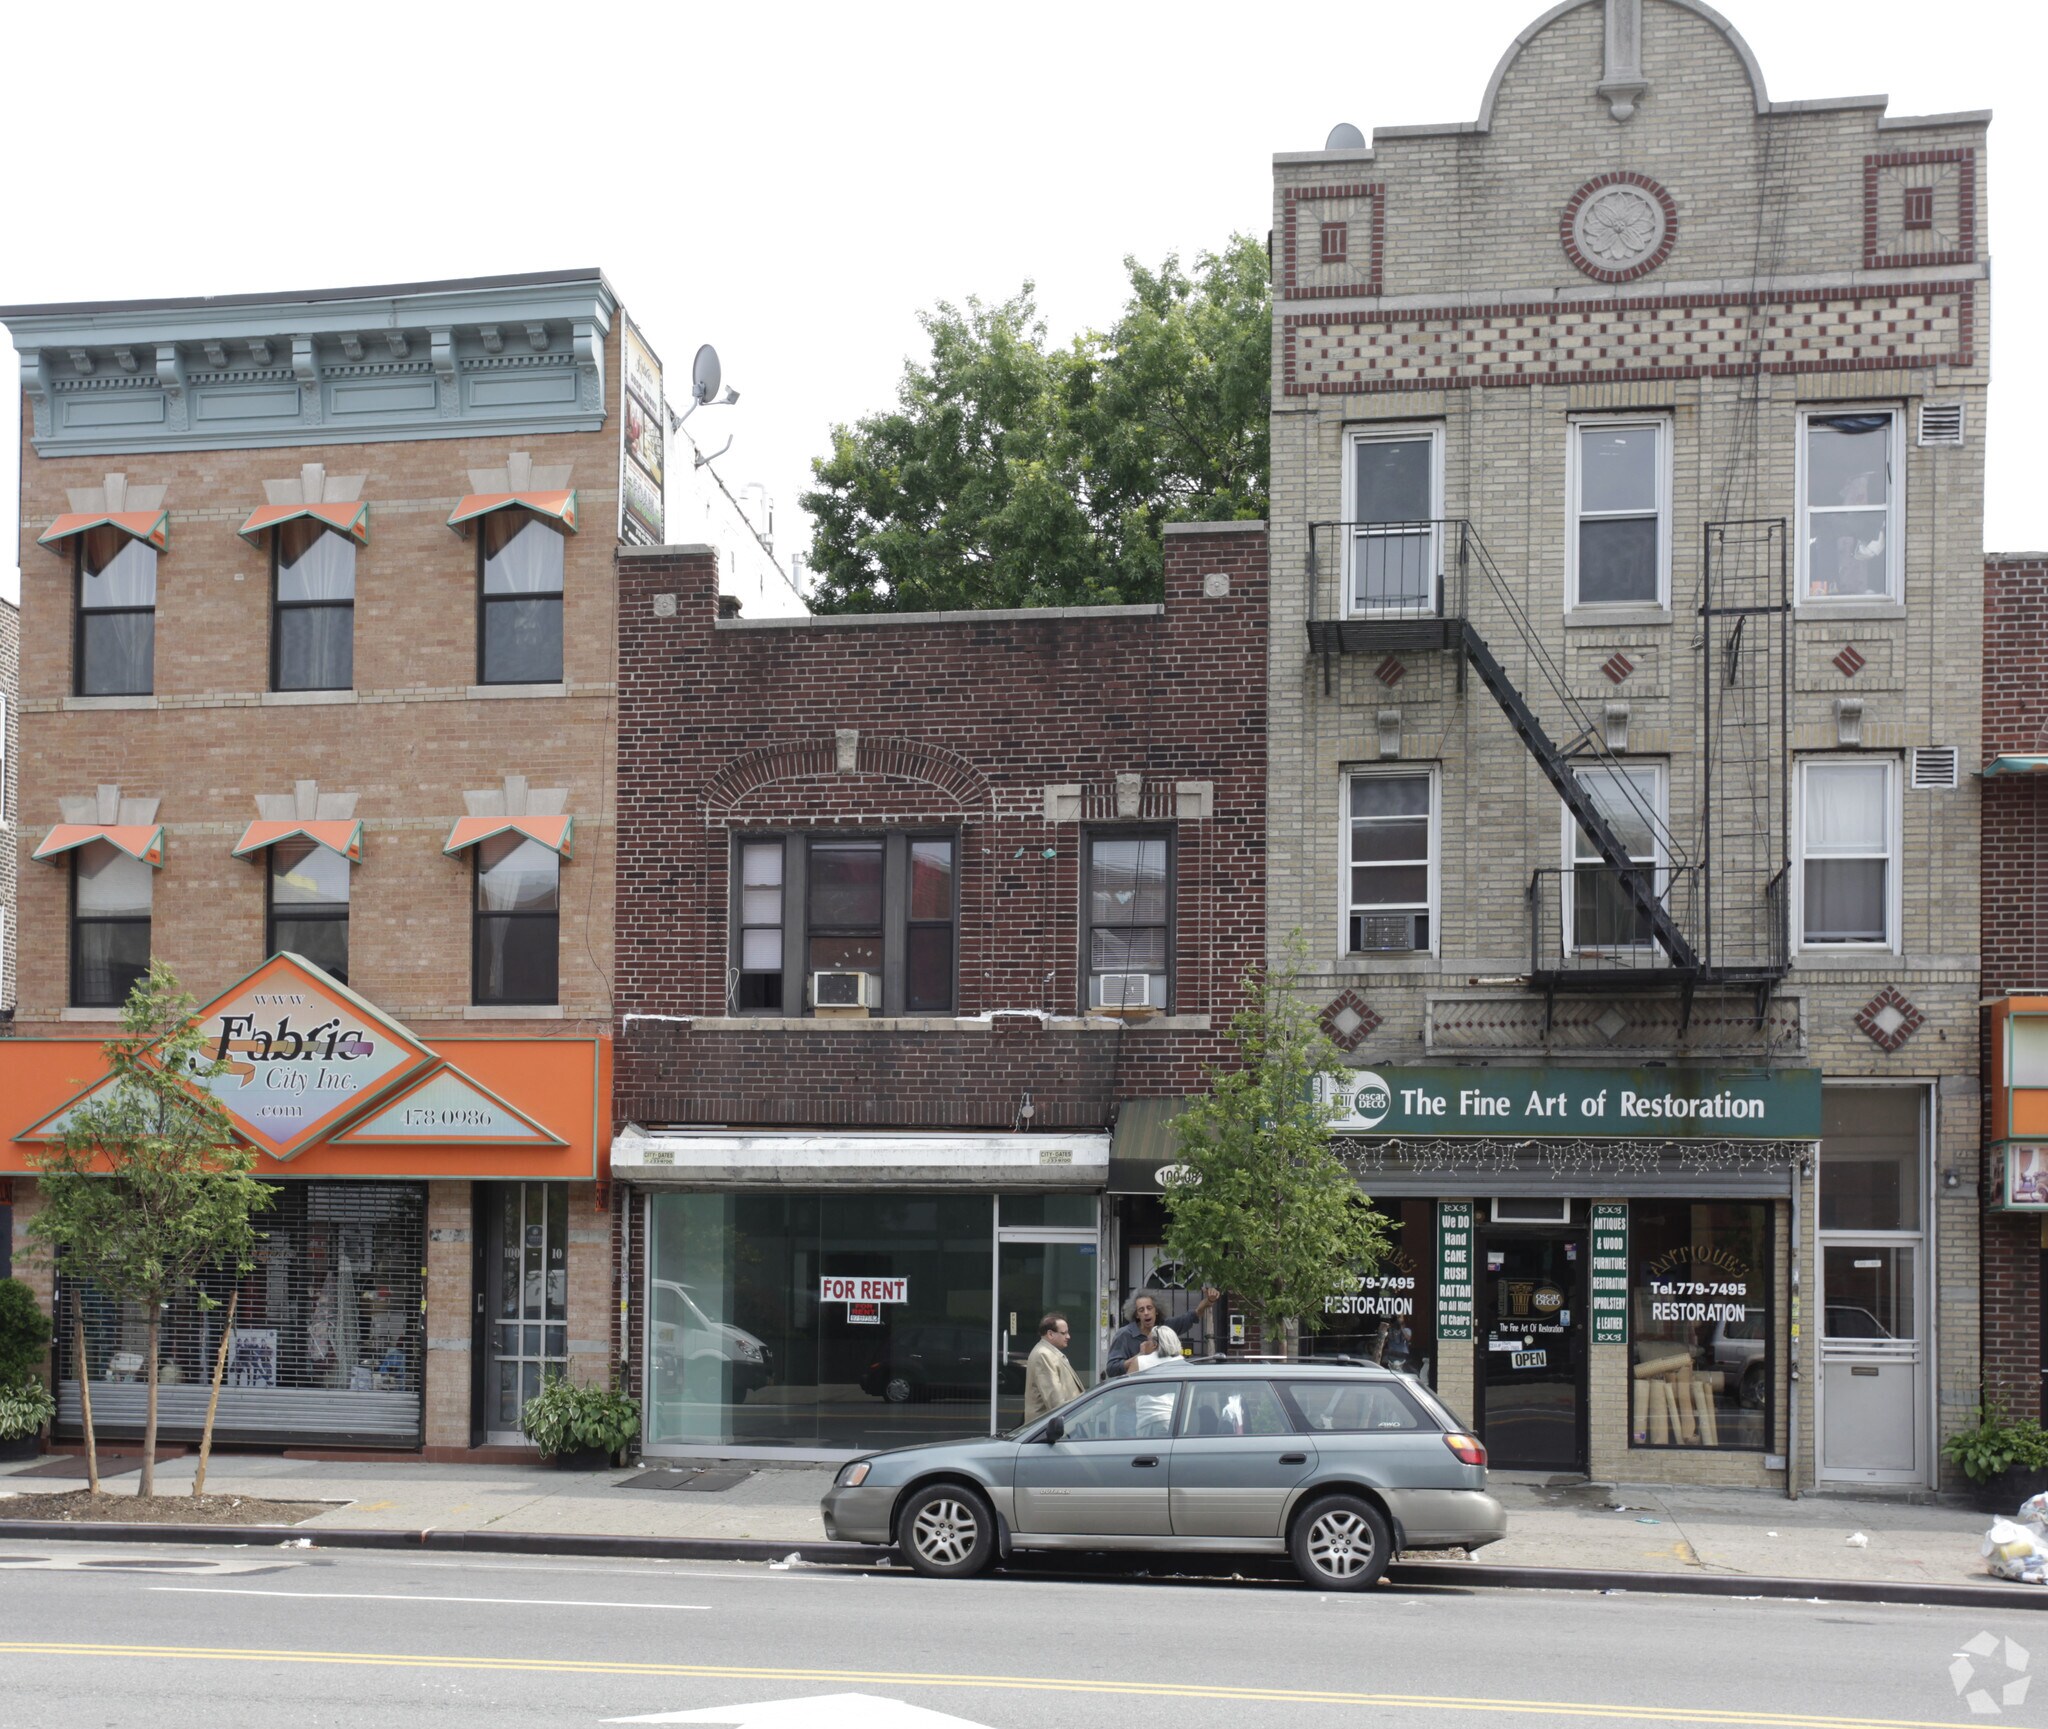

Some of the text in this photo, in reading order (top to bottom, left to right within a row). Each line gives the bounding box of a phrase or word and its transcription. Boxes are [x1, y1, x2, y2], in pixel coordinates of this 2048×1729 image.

[254, 994, 313, 1009] www.
[189, 1013, 373, 1077] Fabric
[266, 1067, 358, 1095] City Inc.
[1358, 1093, 1385, 1101] oscar
[1400, 1088, 1764, 1118] The Fine Art of Restoration
[1359, 1100, 1386, 1108] DECO
[256, 1104, 303, 1118] .com
[1442, 1215, 1469, 1228] We DO
[1594, 1217, 1626, 1230] ANTIQUES
[1445, 1232, 1466, 1245] Hand
[1597, 1237, 1623, 1250] & WOOD
[1445, 1250, 1466, 1263] CANE
[1649, 1246, 1750, 1278] ANTIQUES
[1594, 1257, 1626, 1270] FURNITURE
[1444, 1267, 1467, 1280] RUSH
[823, 1280, 904, 1300] FOR RENT
[1593, 1277, 1627, 1290] RESTORATION
[1650, 1282, 1747, 1295] Tel.779-7495
[1440, 1284, 1471, 1297] RATTAN
[1439, 1301, 1447, 1311] On
[1594, 1297, 1626, 1310] UPHOLSTERY
[1652, 1302, 1745, 1322] RESTORATION
[1449, 1315, 1470, 1326] Chairs
[1601, 1317, 1623, 1330] LEATHER
[1500, 1323, 1508, 1332] The
[1510, 1322, 1519, 1332] Fine
[1530, 1323, 1537, 1332] Of
[1539, 1324, 1564, 1333] Restoration
[1515, 1352, 1545, 1367] OPEN
